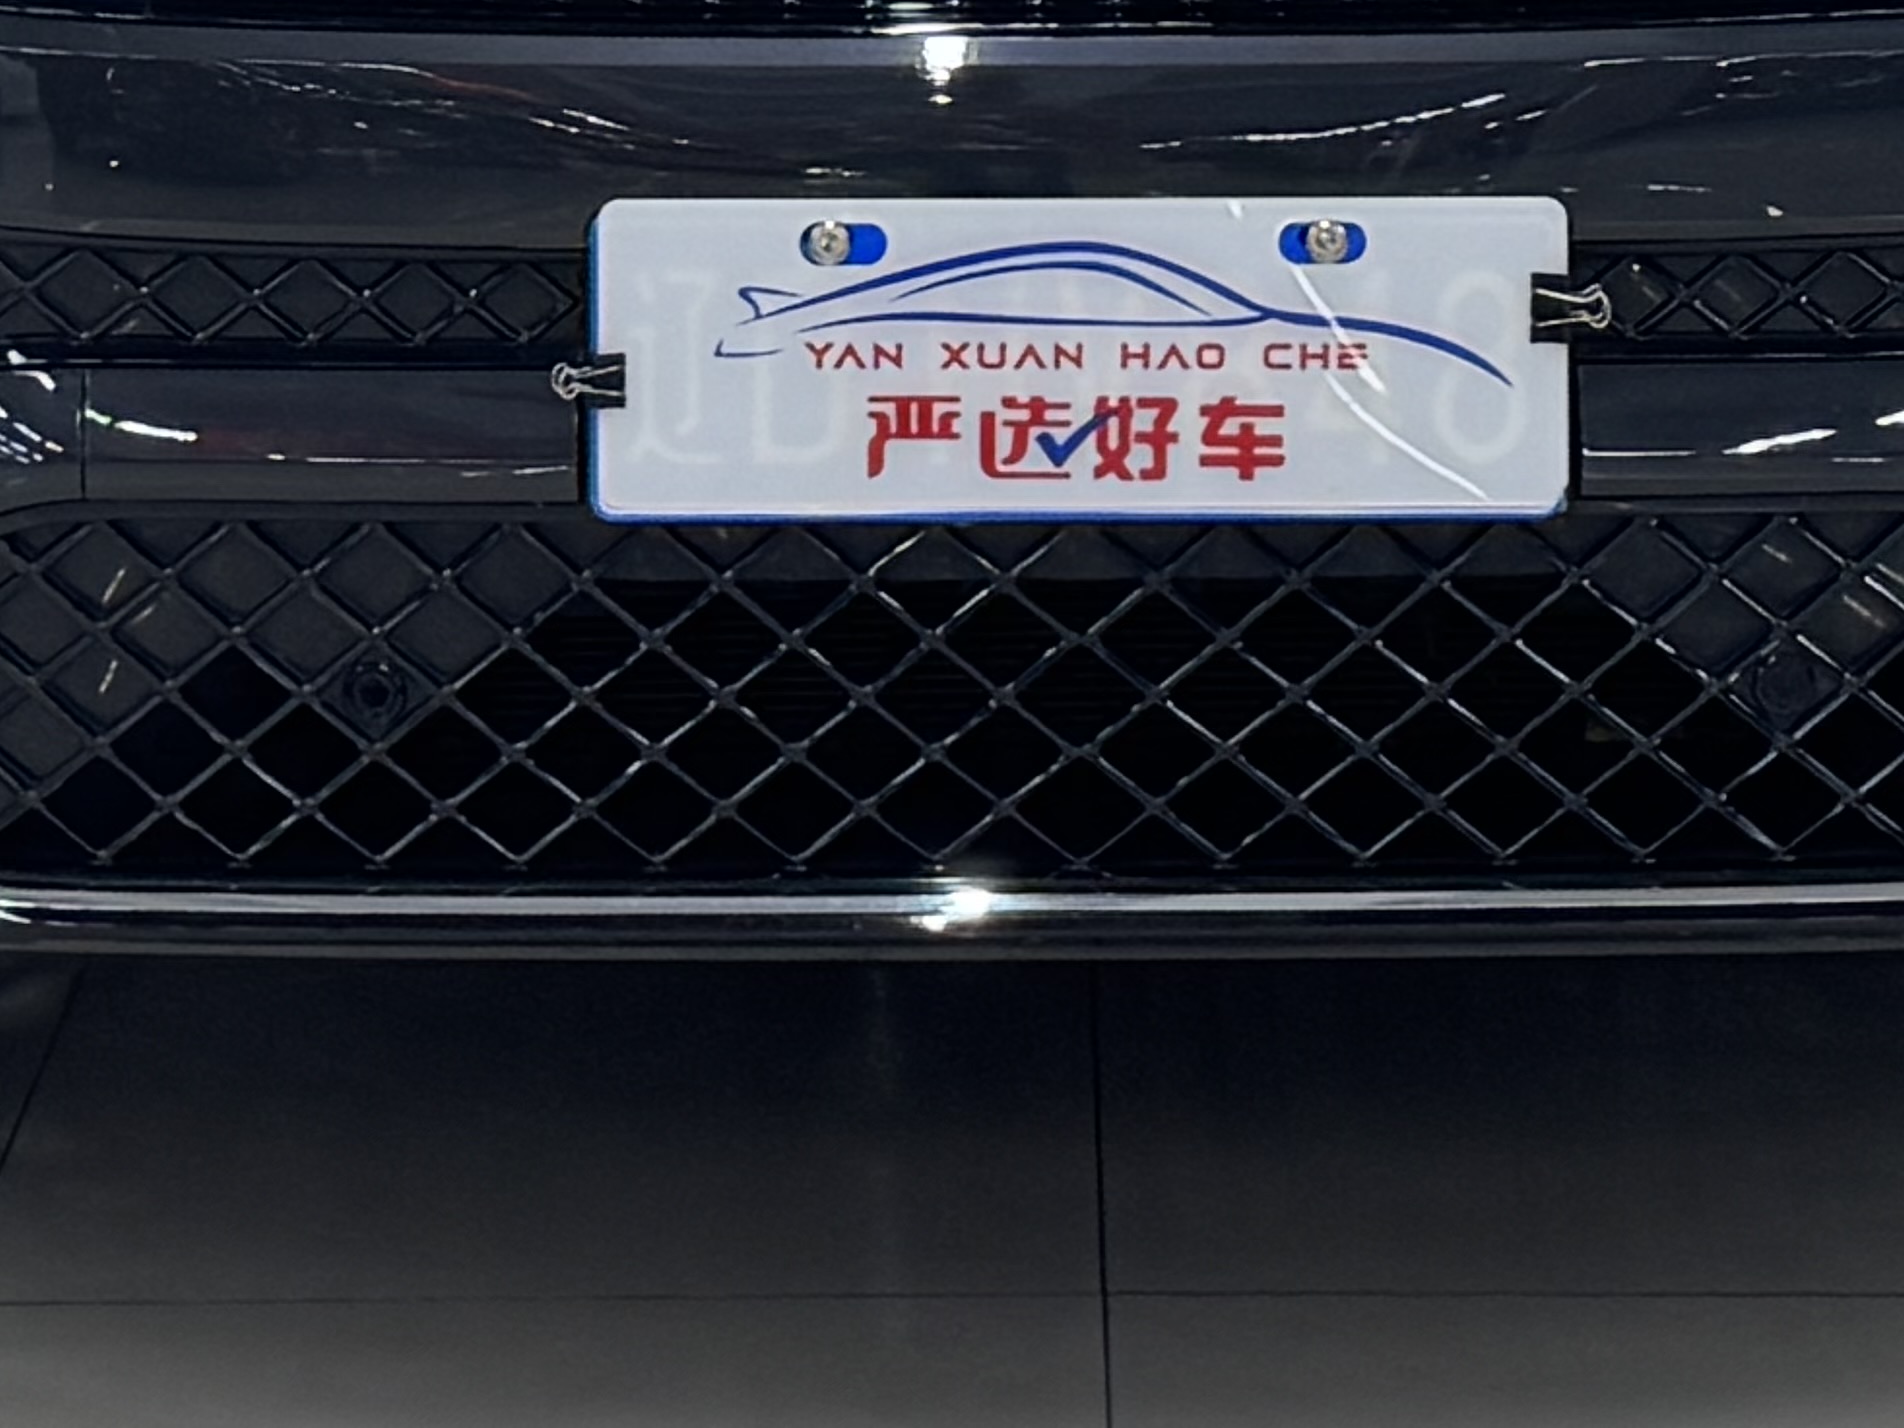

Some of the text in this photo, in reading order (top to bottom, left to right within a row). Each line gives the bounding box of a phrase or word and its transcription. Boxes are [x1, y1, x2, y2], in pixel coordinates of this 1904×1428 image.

[803, 340, 1369, 371] YAN XUAN HAO CHE
[866, 394, 1286, 482] 严选好车
